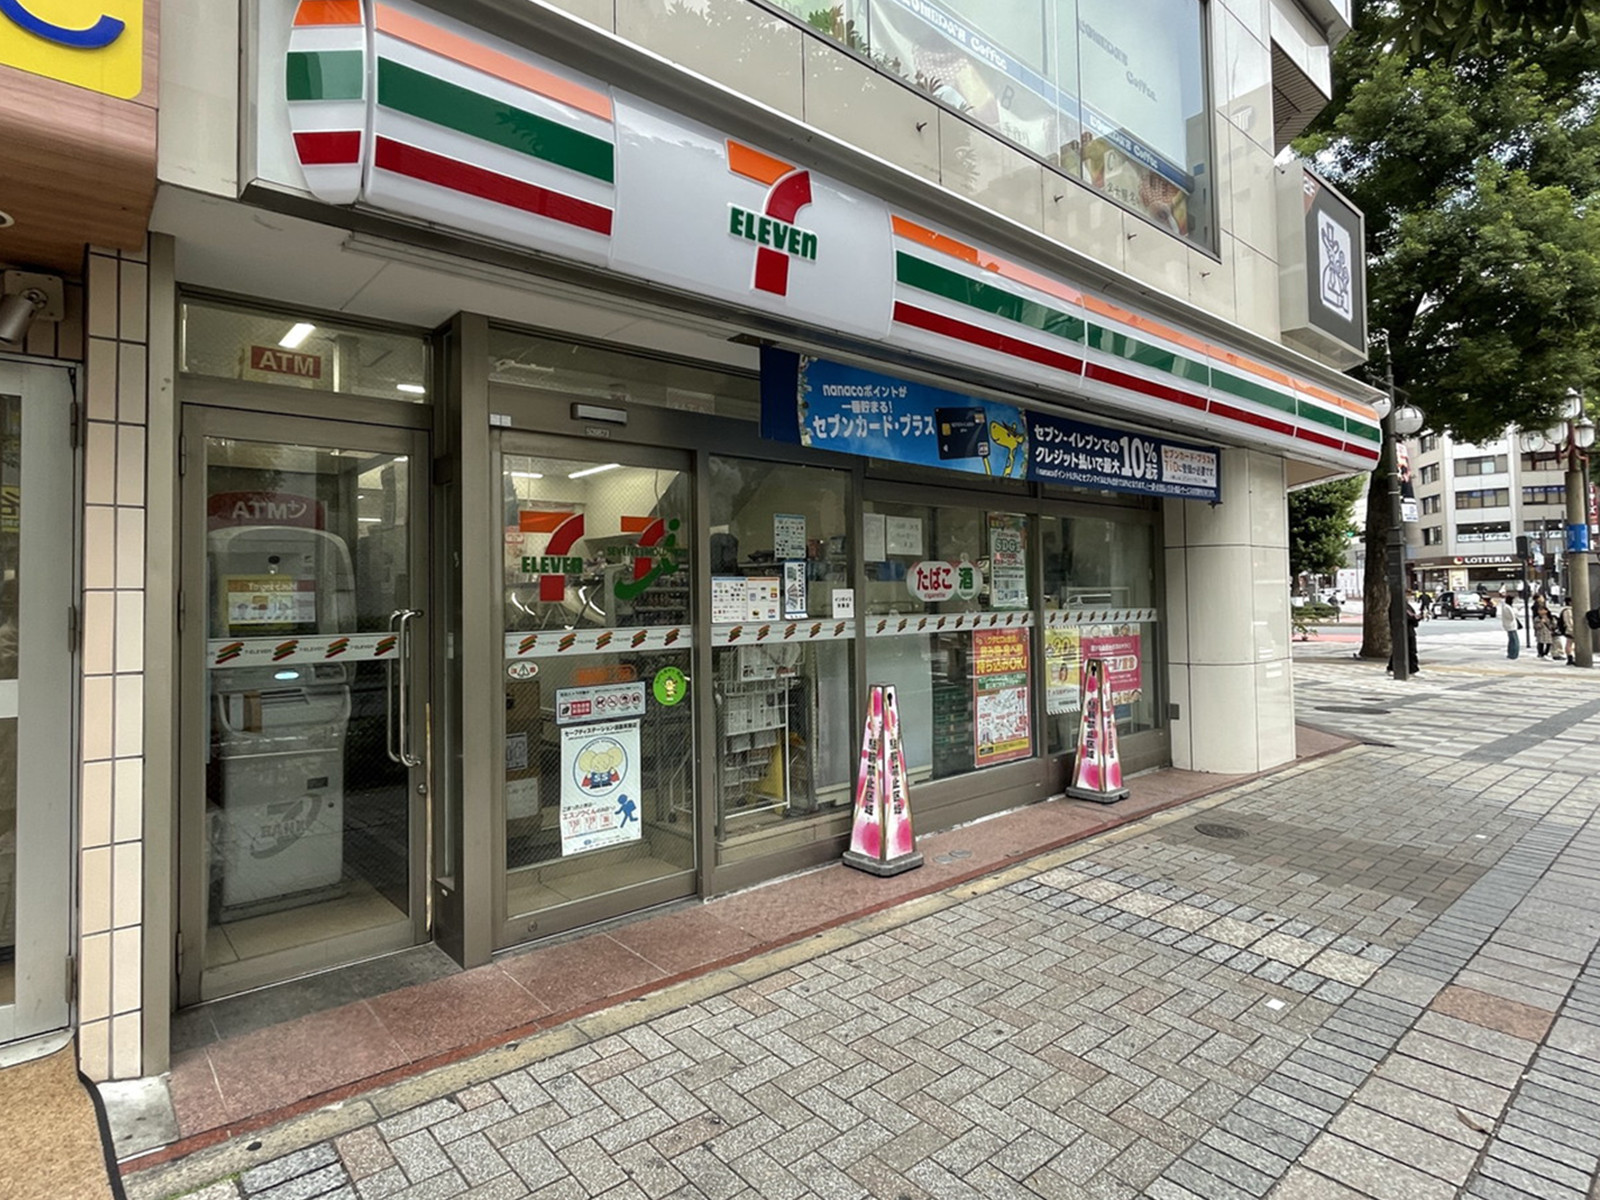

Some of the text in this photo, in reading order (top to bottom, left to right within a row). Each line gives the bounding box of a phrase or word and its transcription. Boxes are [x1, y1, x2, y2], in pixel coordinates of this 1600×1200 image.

[904, 0, 1008, 71] OMEDA'S Coffee
[258, 350, 314, 376] ATM
[823, 384, 908, 398] nanacoポイントが
[812, 413, 936, 439] セブンカード・プラス
[1035, 446, 1121, 475] クレジット払いで最大
[232, 500, 289, 520] ATM
[1464, 556, 1513, 564] LOTTERIA
[916, 566, 953, 591] たばこ
[958, 567, 973, 590] 酒
